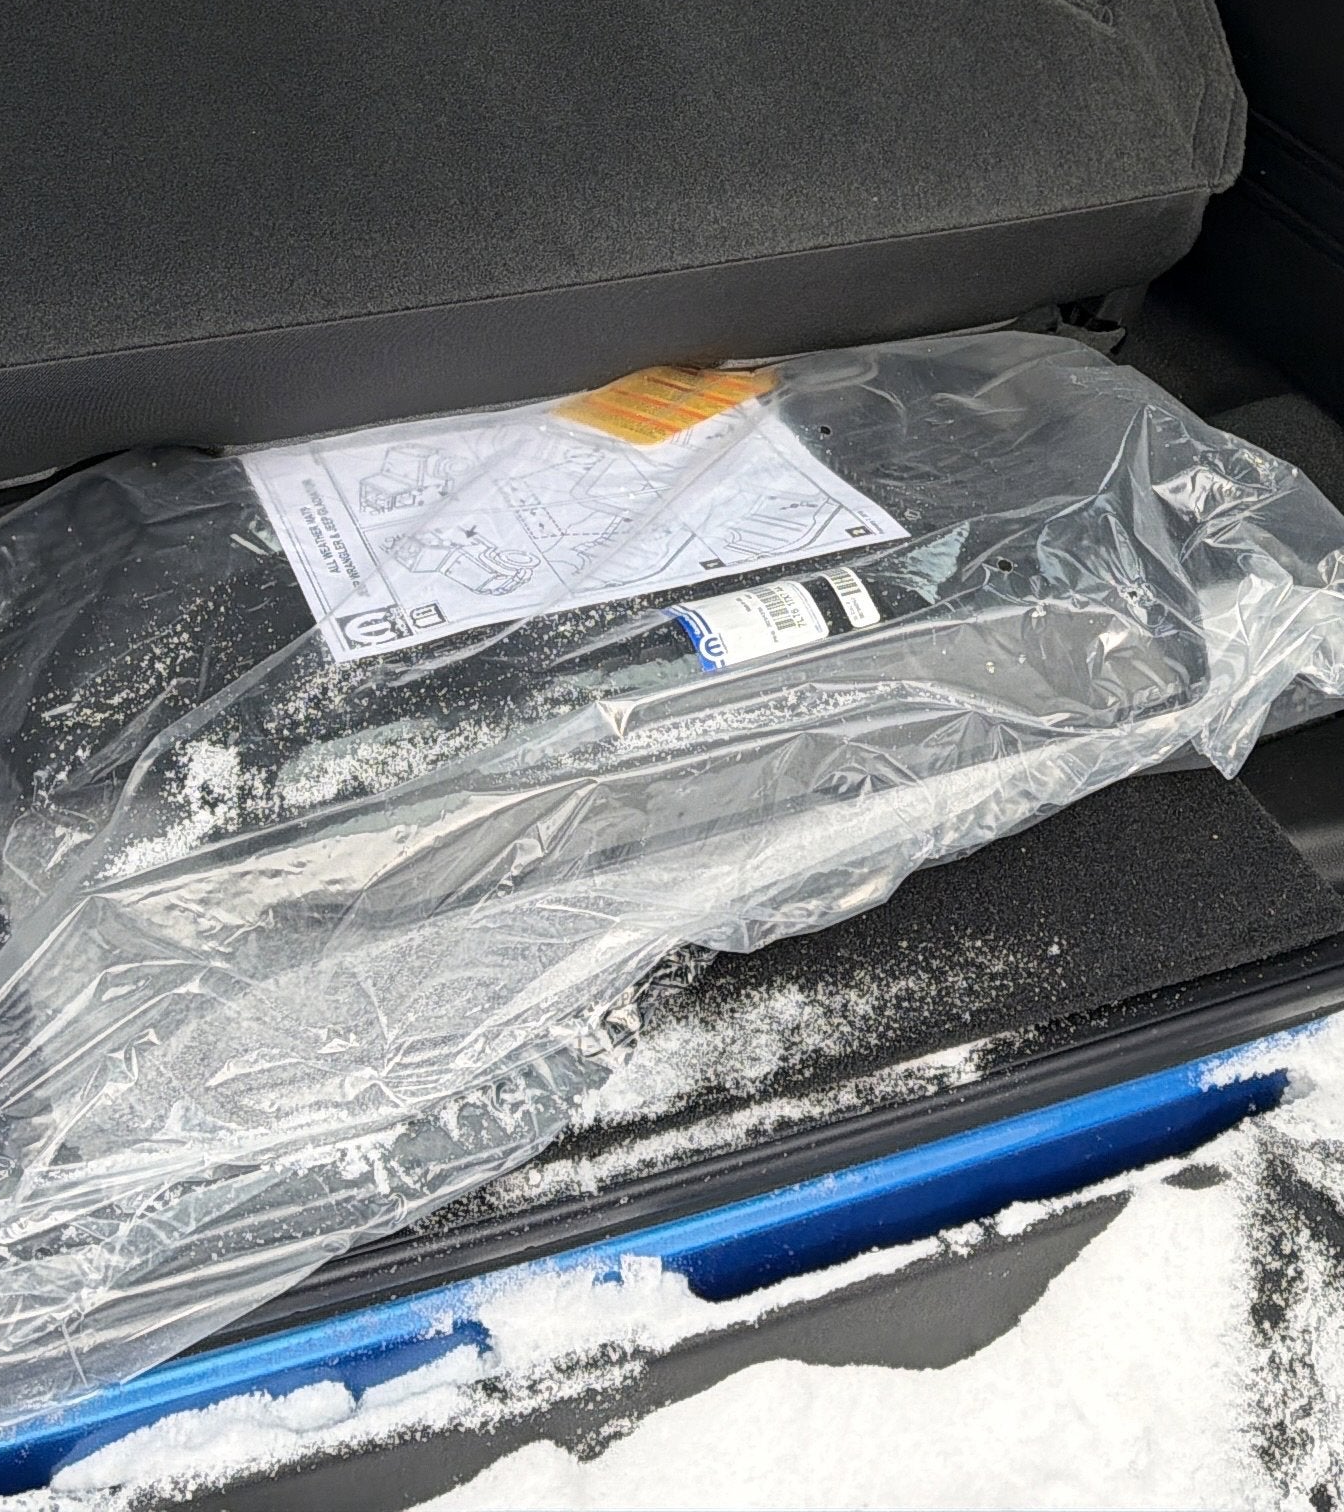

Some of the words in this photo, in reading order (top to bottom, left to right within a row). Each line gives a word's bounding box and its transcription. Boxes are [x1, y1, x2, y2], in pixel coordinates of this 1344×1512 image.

[309, 521, 333, 561] WEATHER
[333, 539, 360, 582] WRANGLER
[327, 558, 341, 574] ALL
